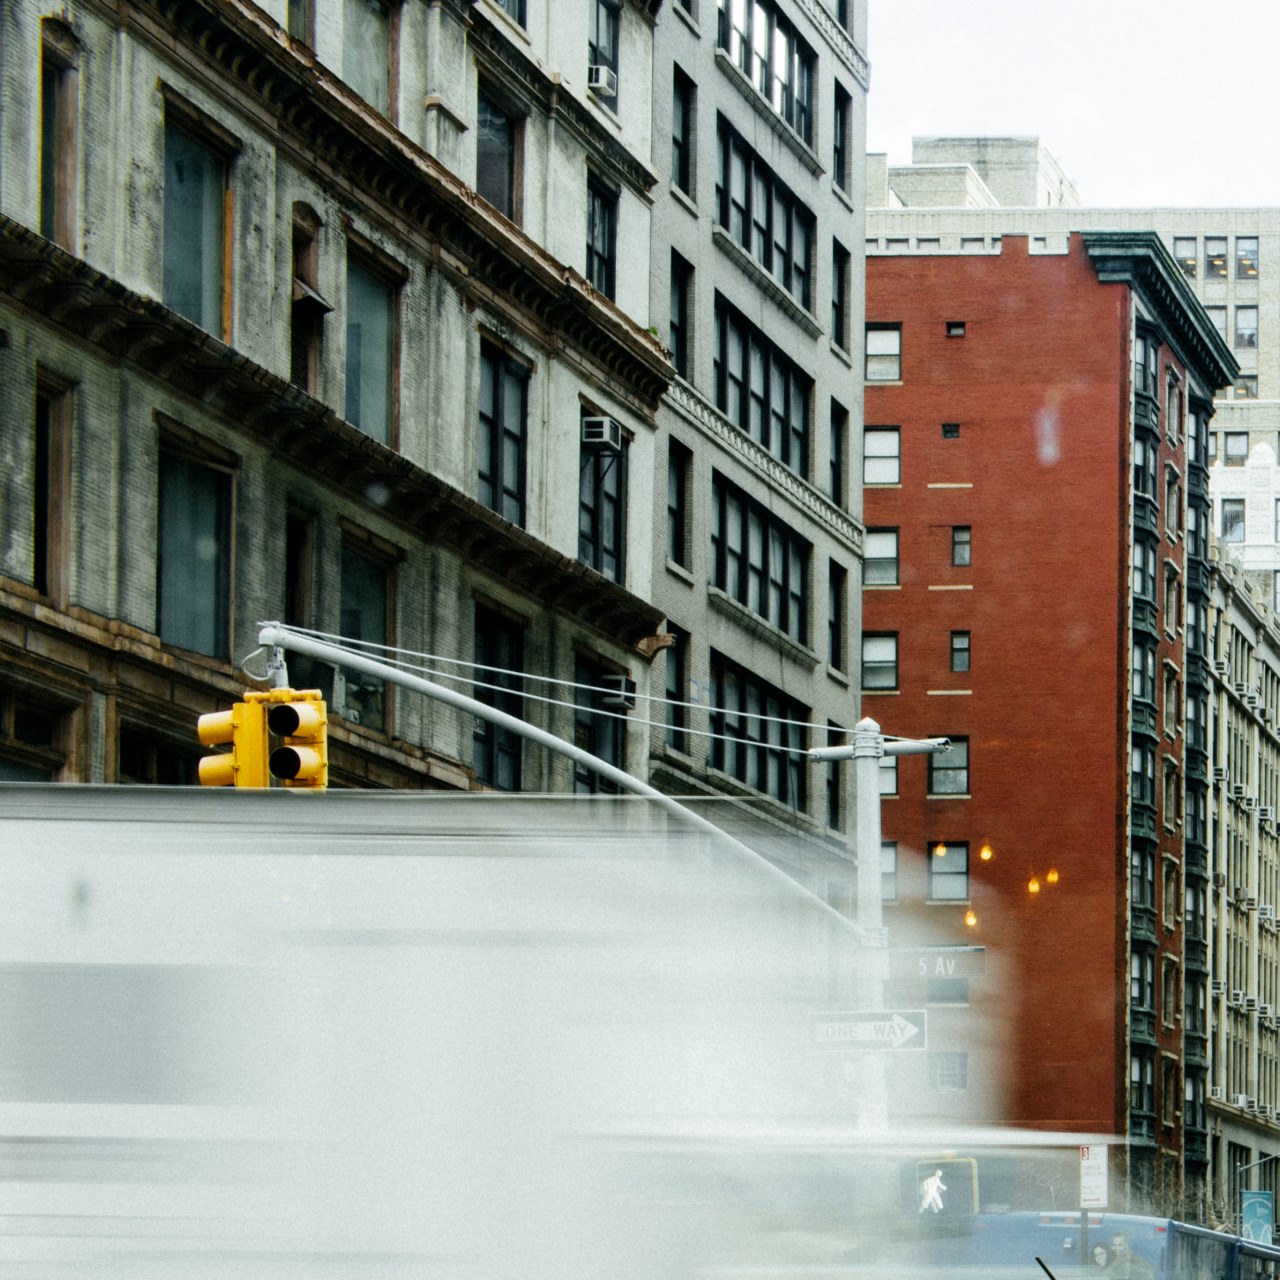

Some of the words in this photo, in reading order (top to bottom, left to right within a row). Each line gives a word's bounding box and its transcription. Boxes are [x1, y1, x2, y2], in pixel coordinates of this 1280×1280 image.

[919, 957, 927, 976] 5
[935, 957, 955, 976] Av
[825, 1024, 855, 1040] ONE
[873, 1022, 908, 1039] WAY
